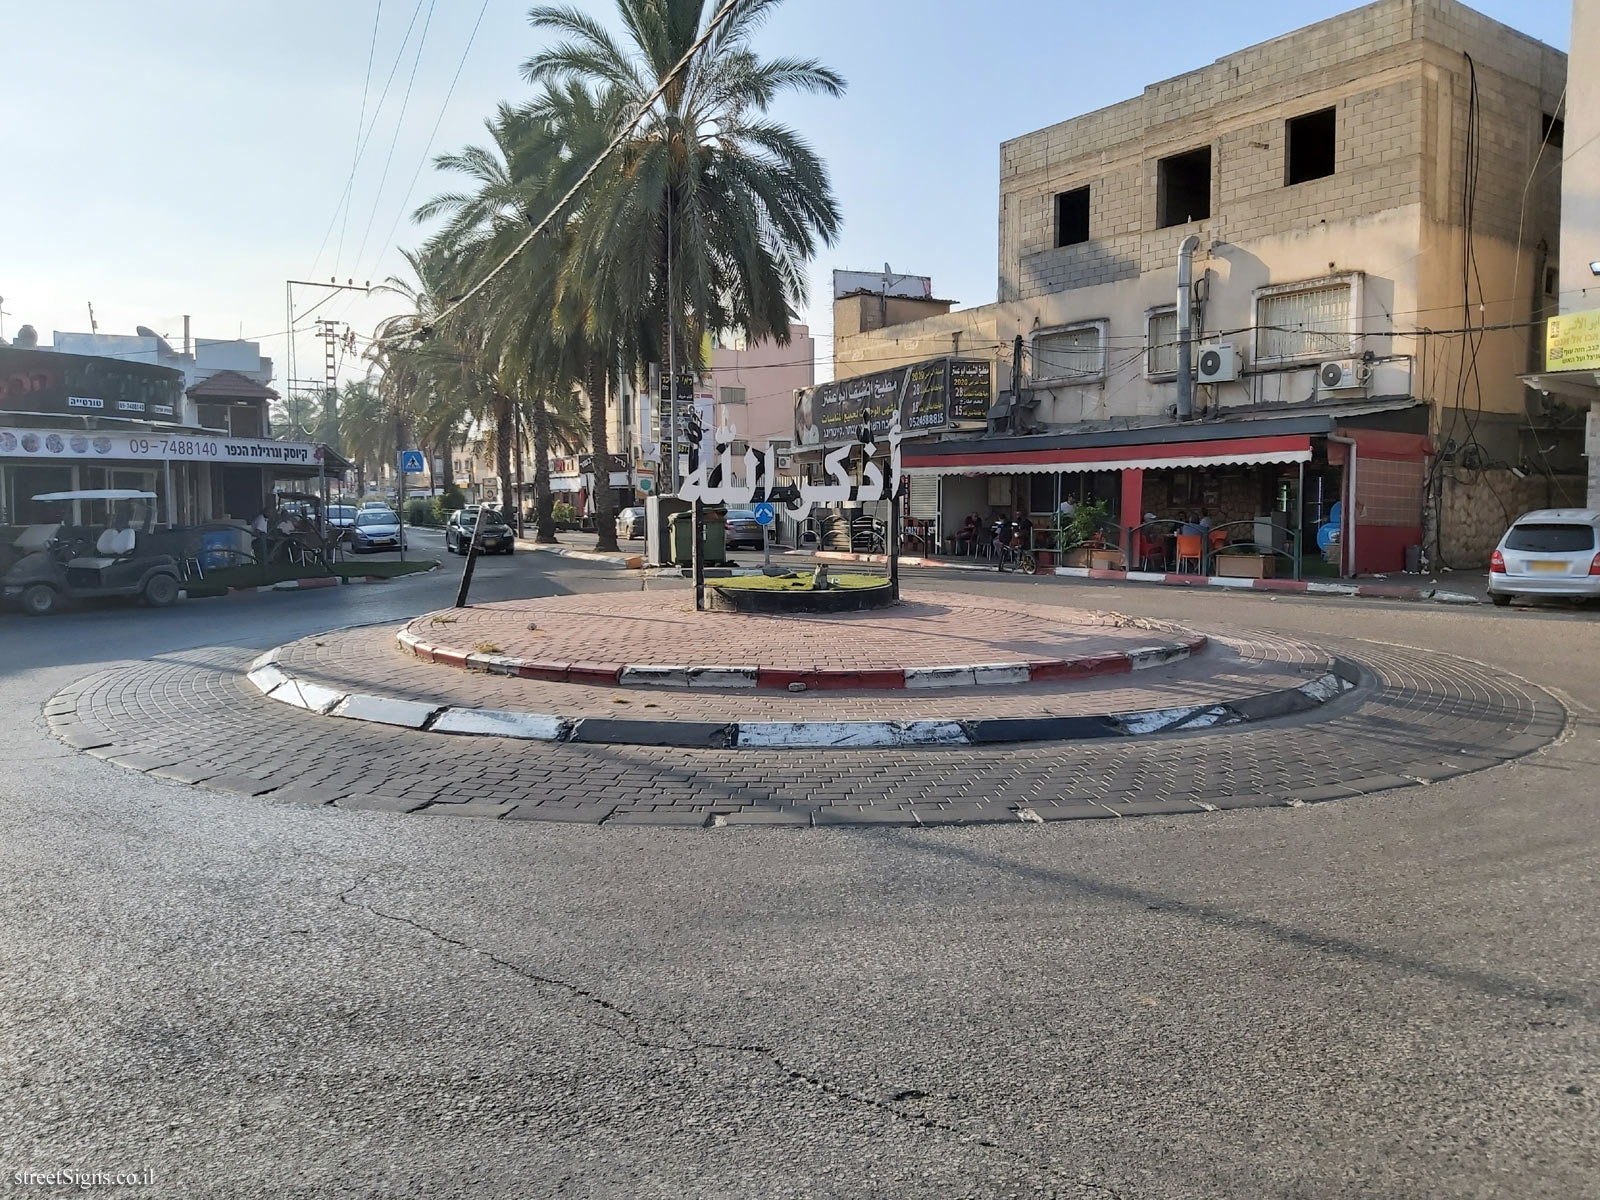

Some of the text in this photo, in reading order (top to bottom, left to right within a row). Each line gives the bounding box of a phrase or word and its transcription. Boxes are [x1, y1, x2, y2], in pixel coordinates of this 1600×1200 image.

[849, 380, 873, 402] الشيف
[875, 379, 897, 398] مطبخ
[955, 387, 963, 397] 28
[955, 406, 963, 416] 15
[129, 439, 218, 456] 09-7488140
[224, 444, 249, 457] הכפר
[283, 448, 308, 461] קיוסק
